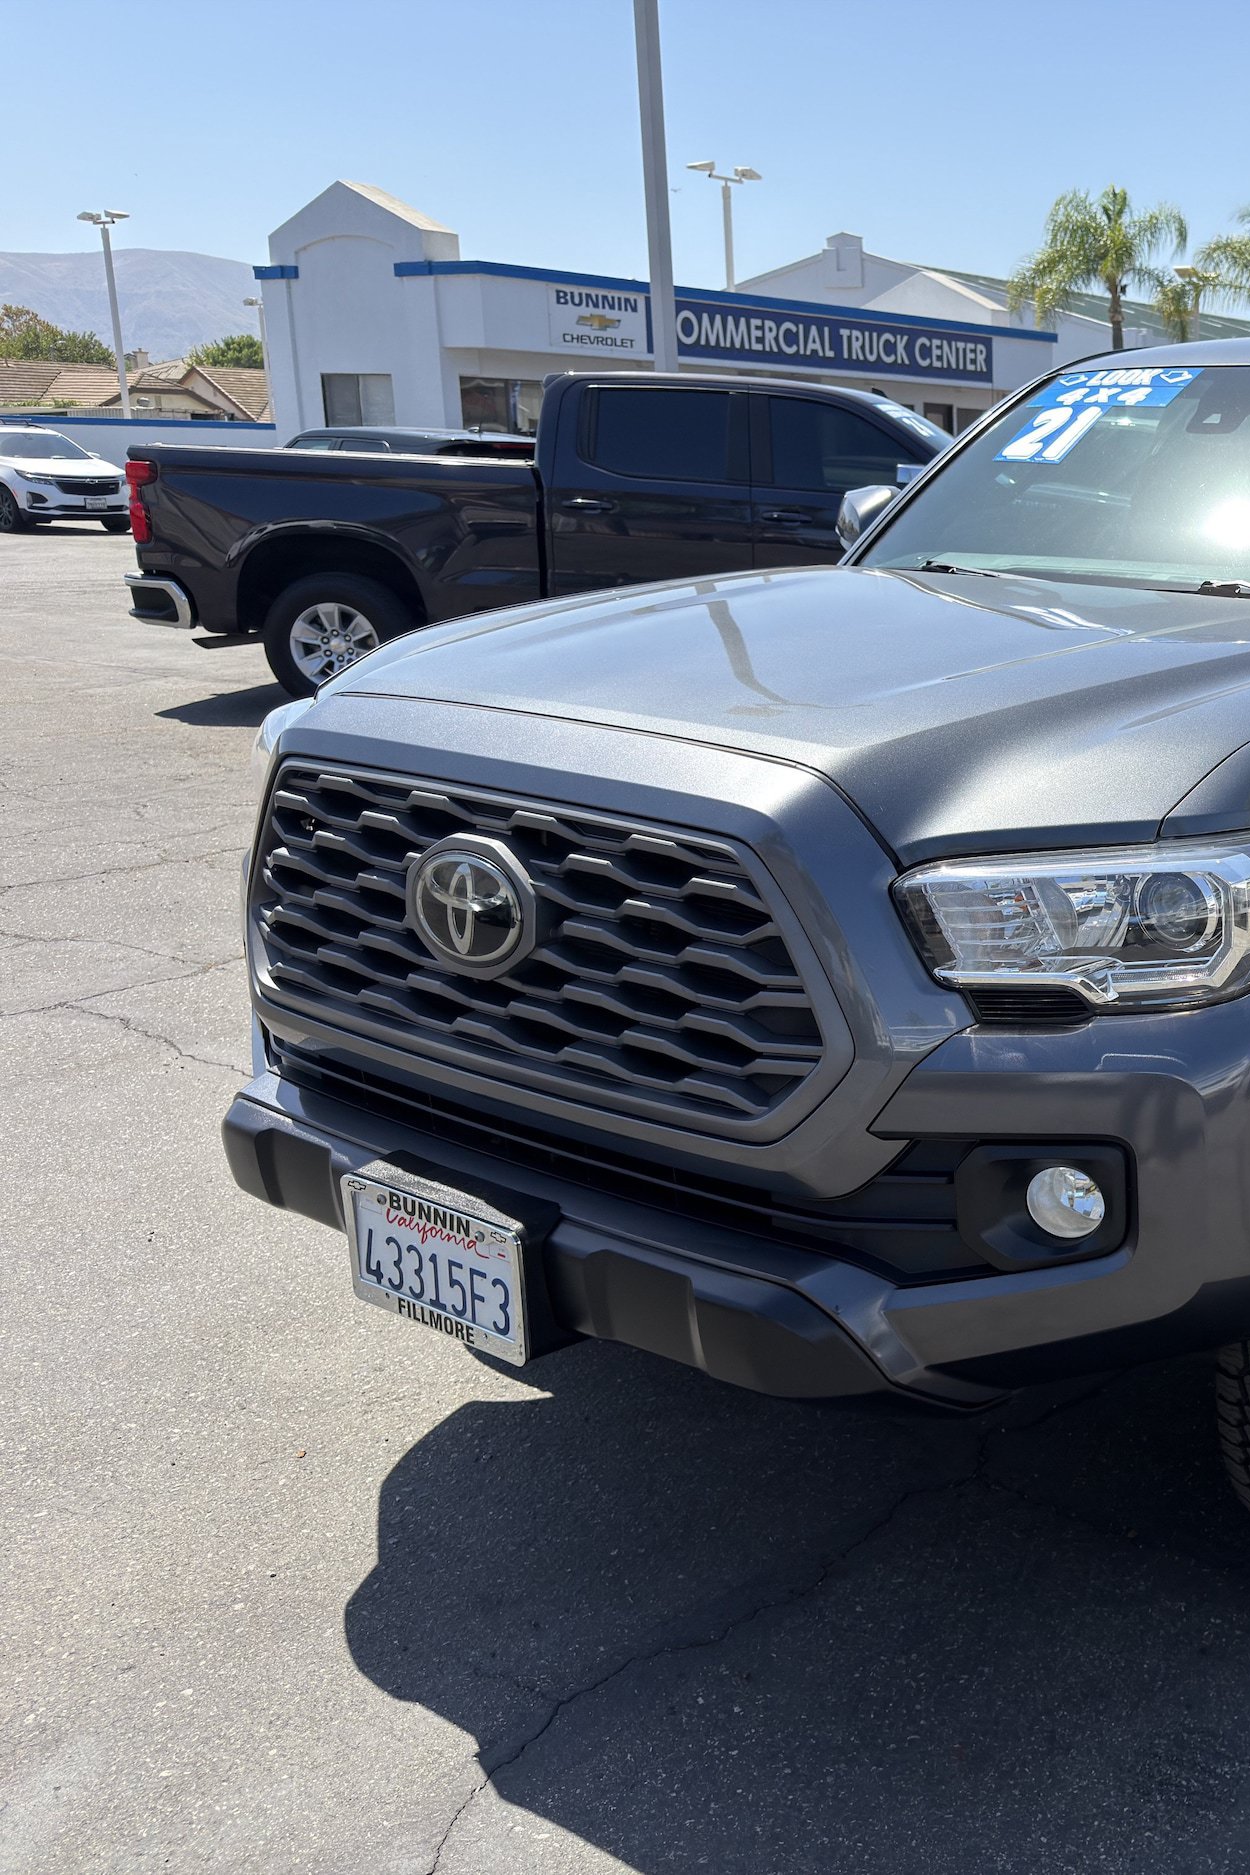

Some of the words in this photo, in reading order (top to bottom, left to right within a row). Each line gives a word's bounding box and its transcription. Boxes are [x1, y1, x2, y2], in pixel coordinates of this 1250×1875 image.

[555, 289, 638, 313] BUNNIN
[562, 333, 636, 349] CHEVROLET
[676, 309, 835, 358] OMMERCIAL
[839, 328, 910, 365] TRUCK
[914, 337, 987, 372] CENTER
[1085, 368, 1164, 386] LOOK
[1002, 406, 1103, 460] 21
[386, 1208, 490, 1259] California
[388, 1191, 471, 1238] BUNNIN
[365, 1228, 510, 1337] 43315F3
[397, 1297, 475, 1345] FILLMORE
